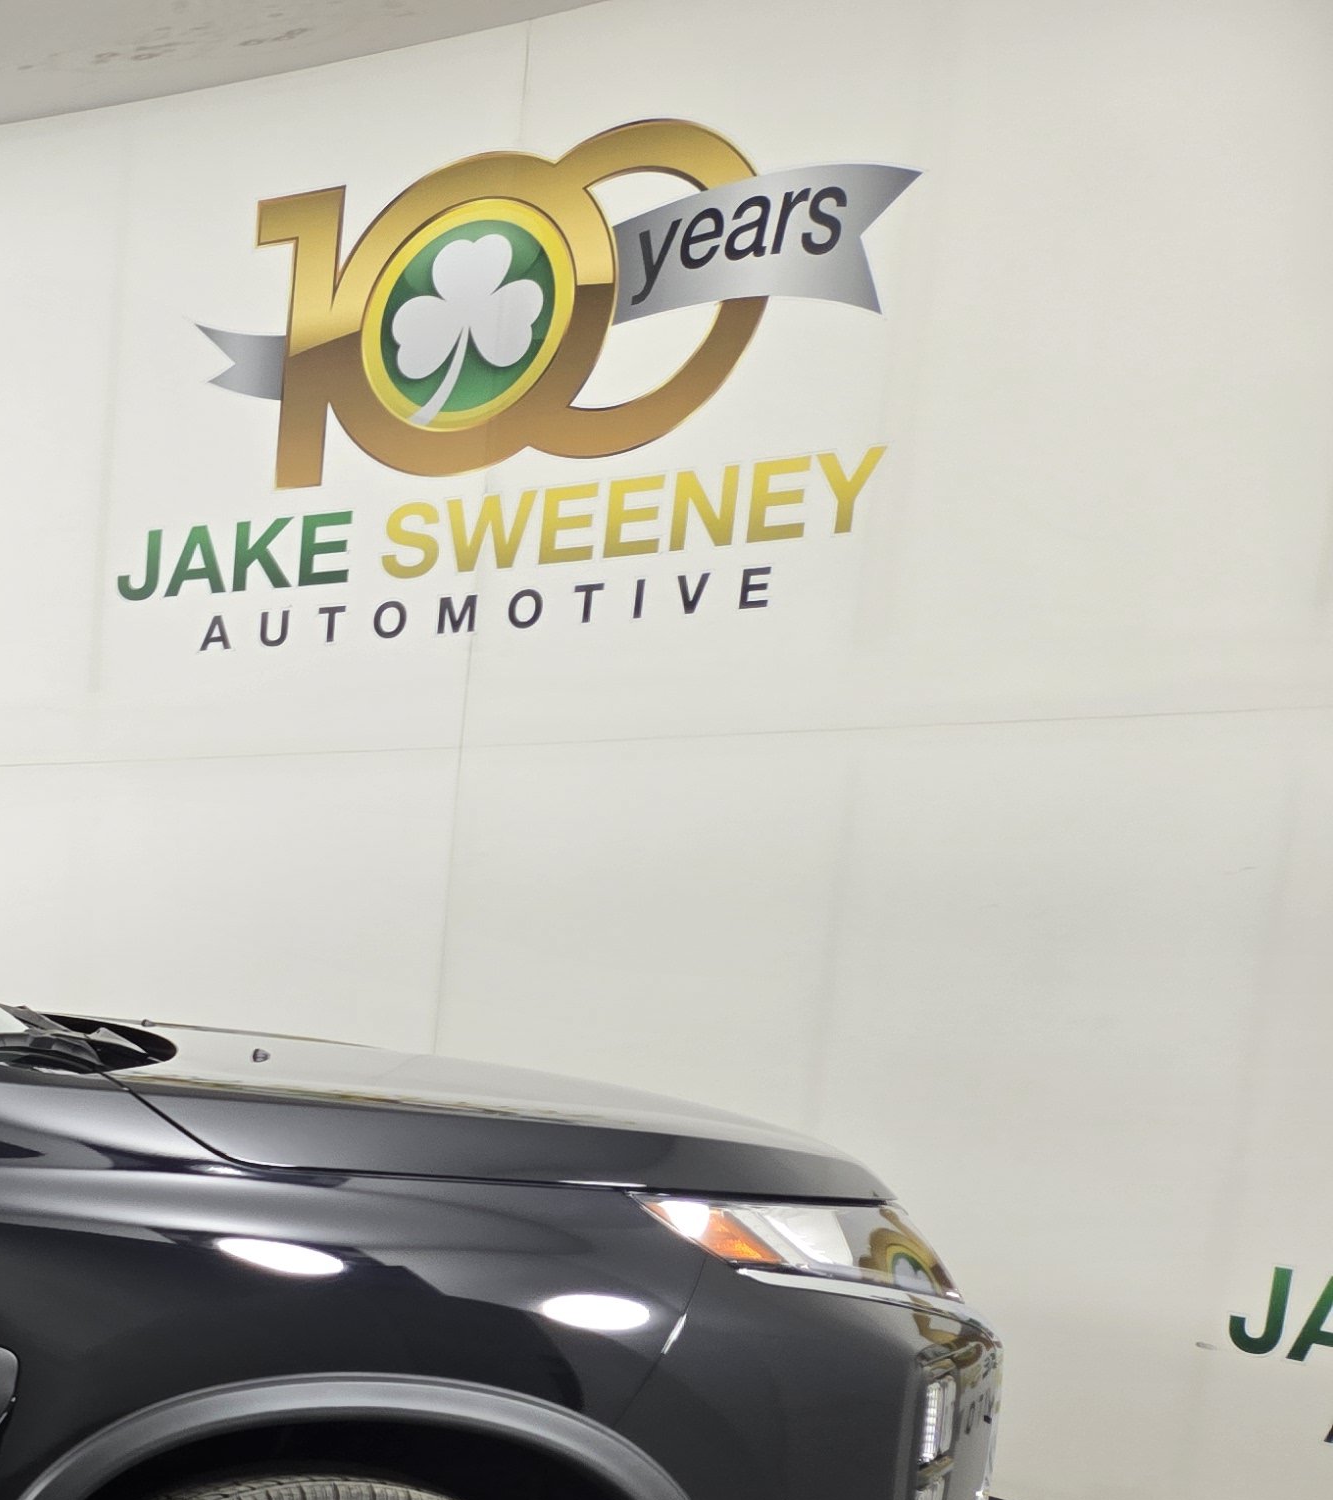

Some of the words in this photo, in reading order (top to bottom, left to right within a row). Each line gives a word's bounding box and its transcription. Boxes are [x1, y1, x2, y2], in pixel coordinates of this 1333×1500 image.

[632, 183, 849, 306] years
[116, 510, 355, 602] JAKE
[381, 444, 889, 580] SWEENEY
[199, 566, 774, 652] AUTOMOTIVE
